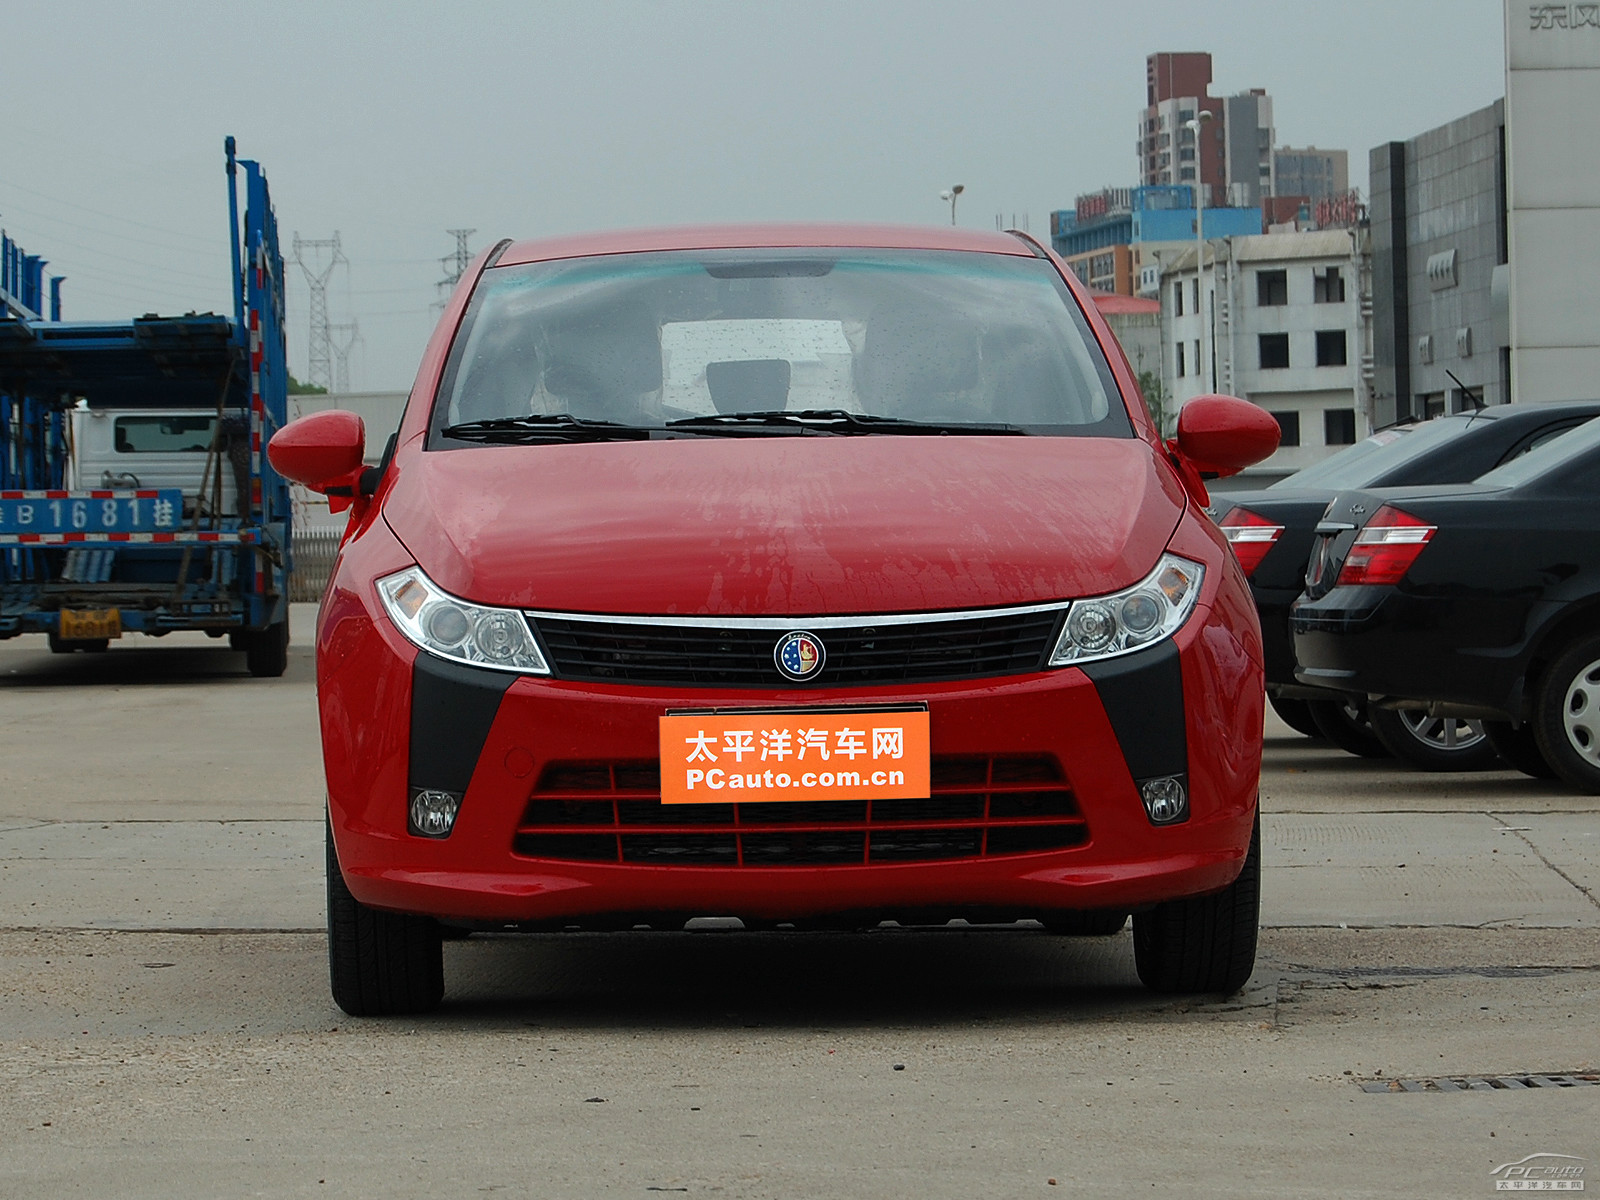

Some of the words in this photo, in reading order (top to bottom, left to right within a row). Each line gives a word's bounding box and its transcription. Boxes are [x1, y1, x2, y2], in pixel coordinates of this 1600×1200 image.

[0, 499, 174, 528] B1681挂
[685, 727, 904, 763] 太平洋汽车网
[686, 768, 905, 790] PCauto.com.cn
